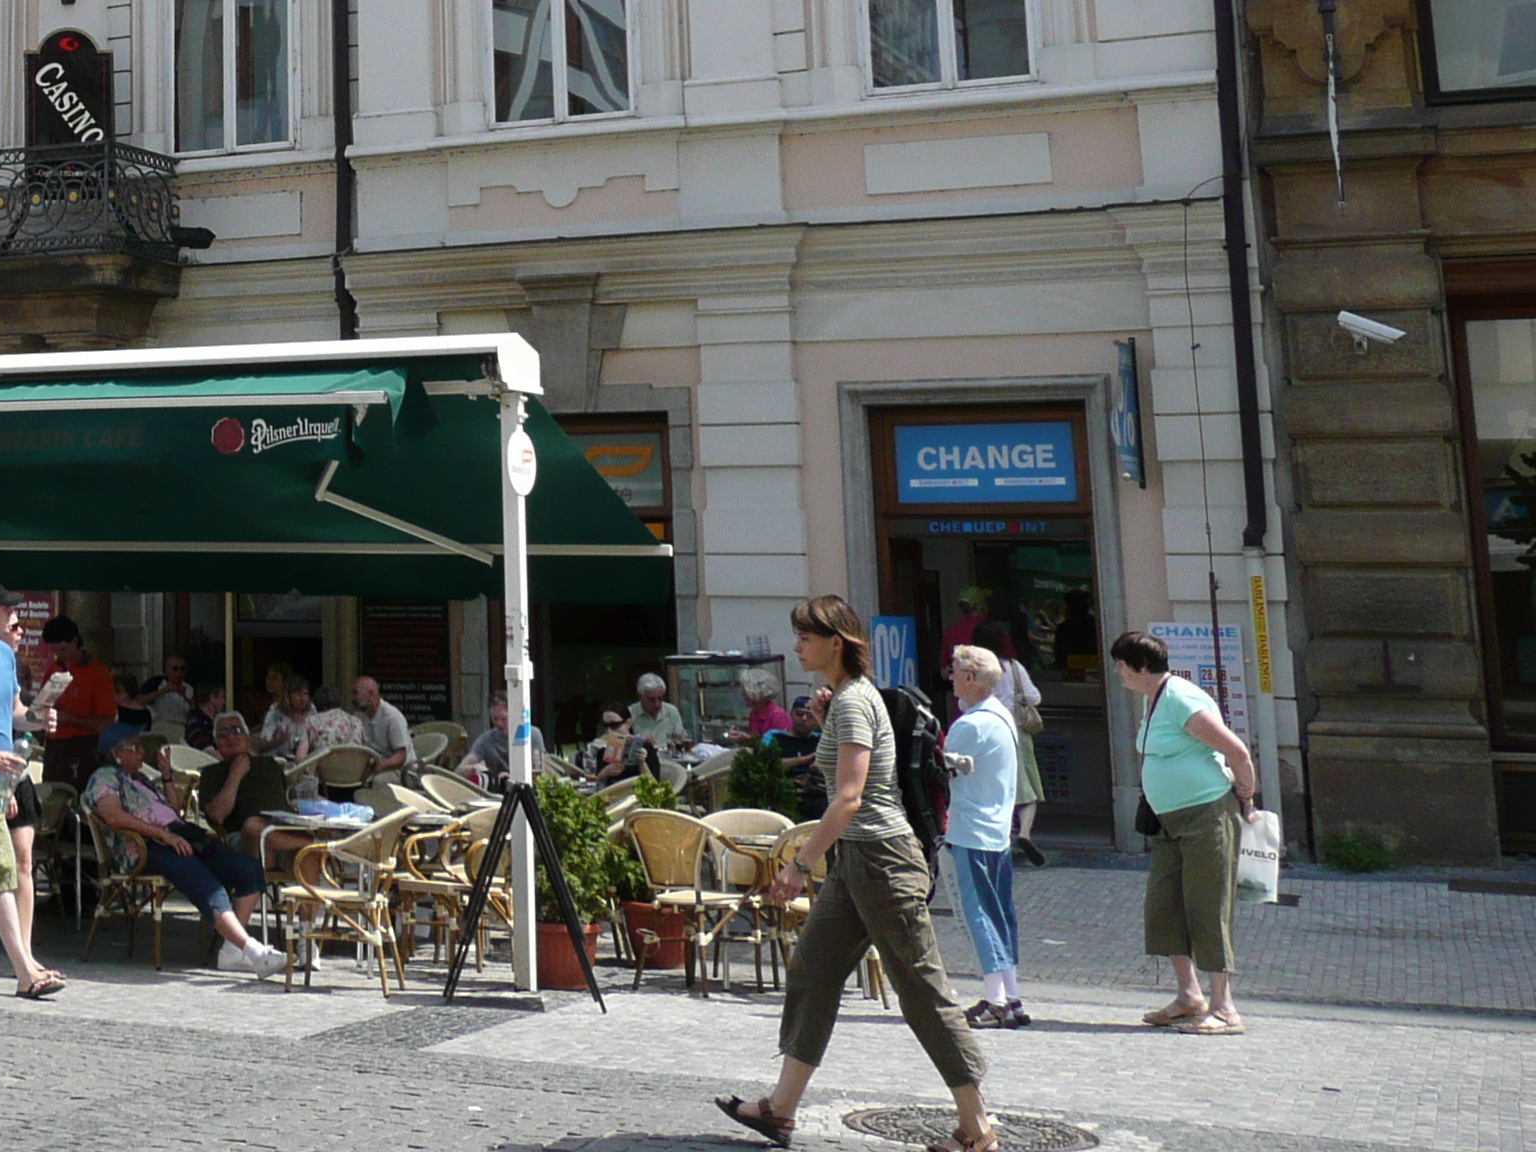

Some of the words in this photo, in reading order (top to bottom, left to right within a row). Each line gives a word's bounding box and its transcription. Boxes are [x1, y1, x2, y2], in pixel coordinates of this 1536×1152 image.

[35, 62, 104, 143] CASINO
[250, 418, 299, 454] Pilsner
[917, 444, 1056, 471] CHANGE
[1151, 626, 1238, 638] CHANGE
